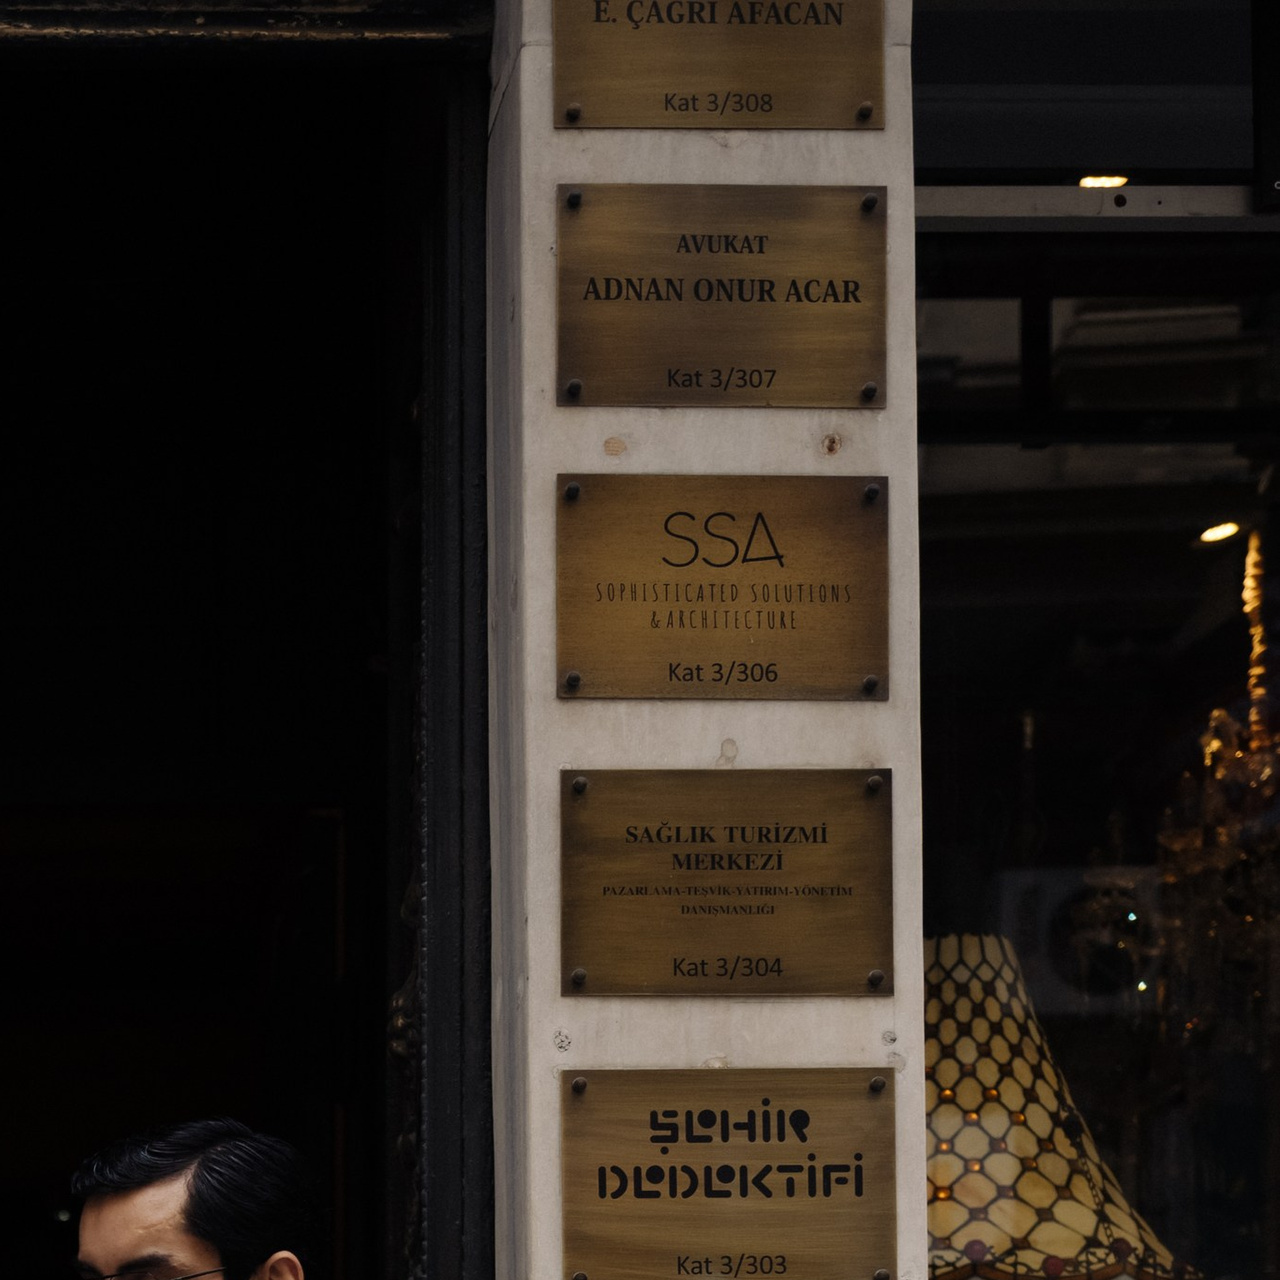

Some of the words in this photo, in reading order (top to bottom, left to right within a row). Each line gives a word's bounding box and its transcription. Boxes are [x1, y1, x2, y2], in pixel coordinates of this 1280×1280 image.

[594, 0, 616, 23] E.
[727, 1, 843, 26] AFACAN
[665, 94, 698, 111] Kat
[707, 92, 773, 115] 3/308
[677, 235, 768, 254] AVUKAT
[583, 277, 684, 301] ADNAN
[694, 279, 776, 302] ONUR
[785, 280, 861, 302] ACAR
[668, 369, 702, 387] Kat
[711, 367, 776, 391] 3/307
[662, 512, 784, 567] SSA
[597, 583, 738, 602] SOPHISTICATED
[751, 584, 852, 604] SOLUTIONS
[669, 663, 703, 681] Kat
[712, 661, 777, 685] 3/306
[626, 822, 716, 843] SAĞLIK
[724, 823, 827, 843] TURİZMİ
[673, 854, 782, 870] MERKEZİ
[674, 958, 708, 976] Kat
[716, 956, 783, 980] 3/304
[678, 1256, 712, 1274] Kat
[721, 1254, 786, 1278] 3/303
